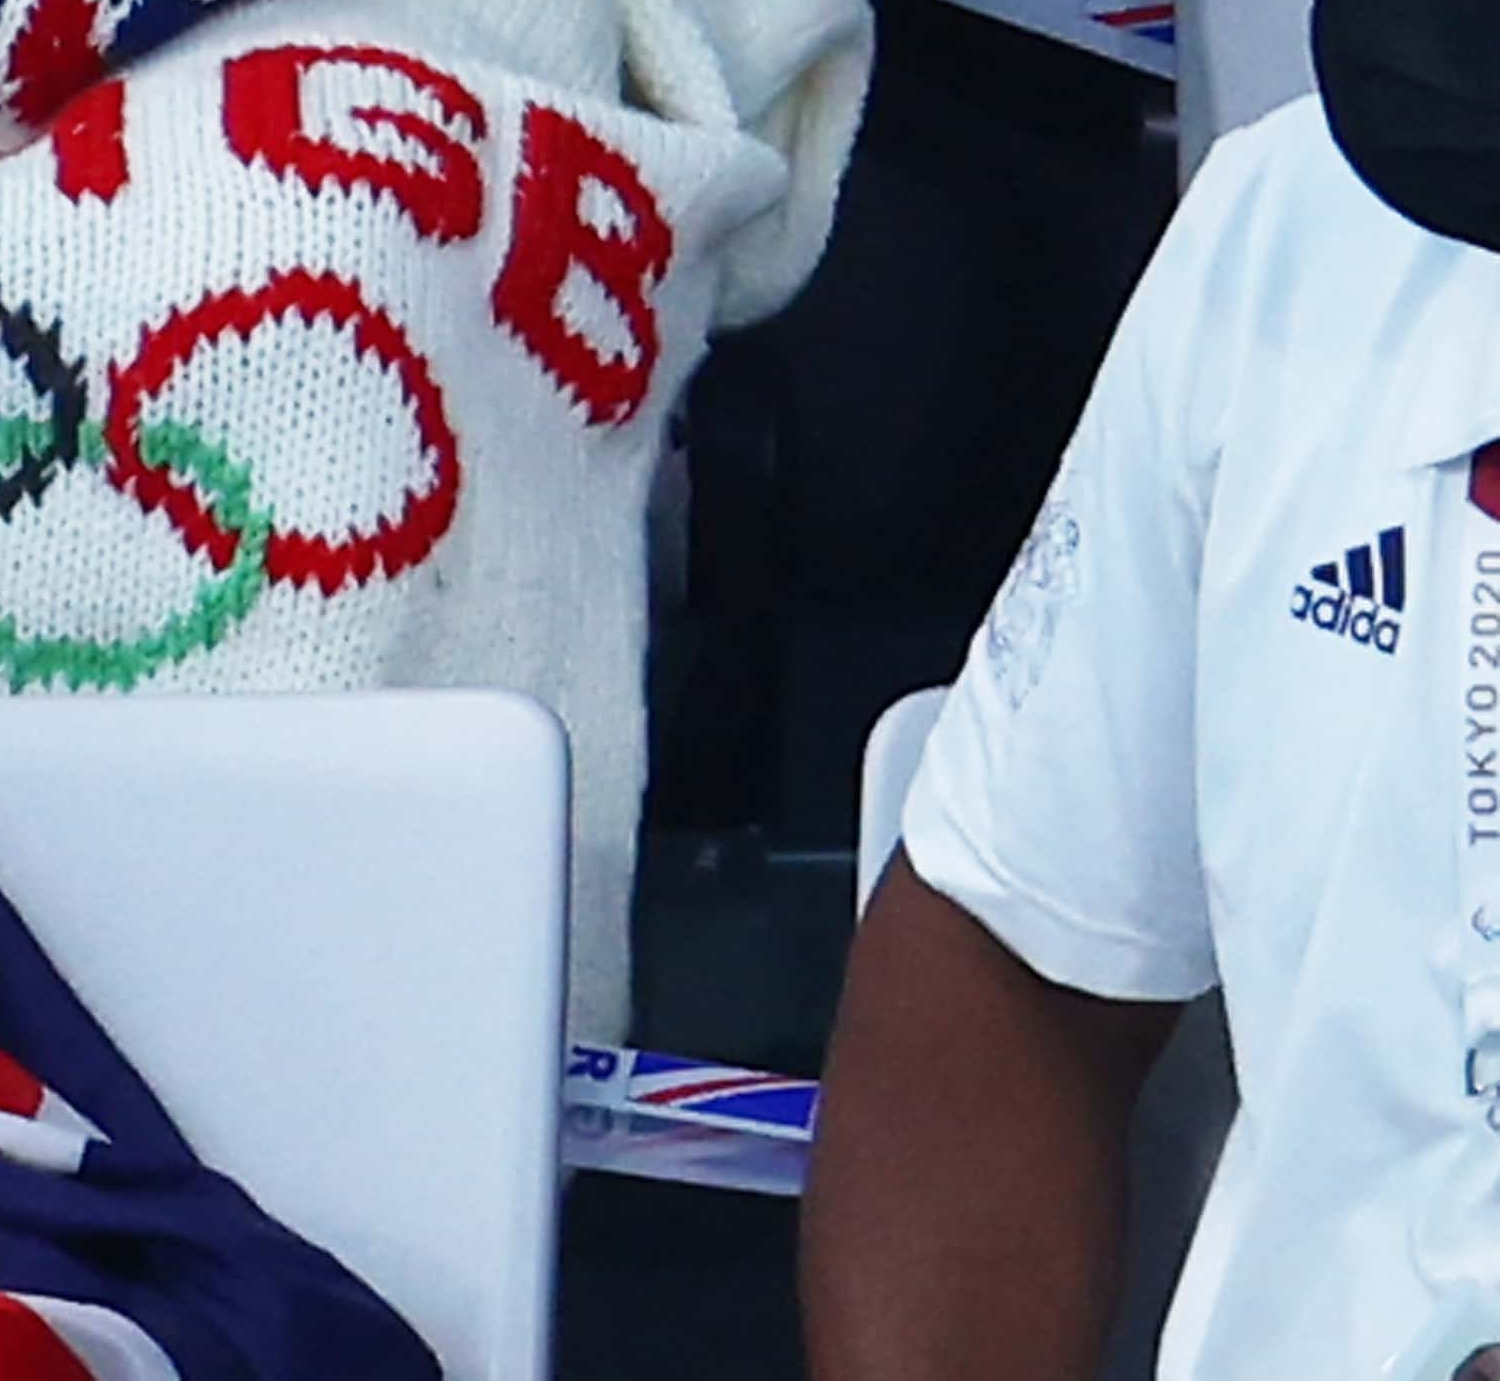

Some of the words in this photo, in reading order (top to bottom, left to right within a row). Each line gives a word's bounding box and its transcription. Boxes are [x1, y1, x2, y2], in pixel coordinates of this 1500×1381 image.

[221, 44, 674, 427] GB
[1289, 584, 1402, 655] adida
[1468, 550, 1500, 669] 2020
[1465, 684, 1500, 848] TOKYO
